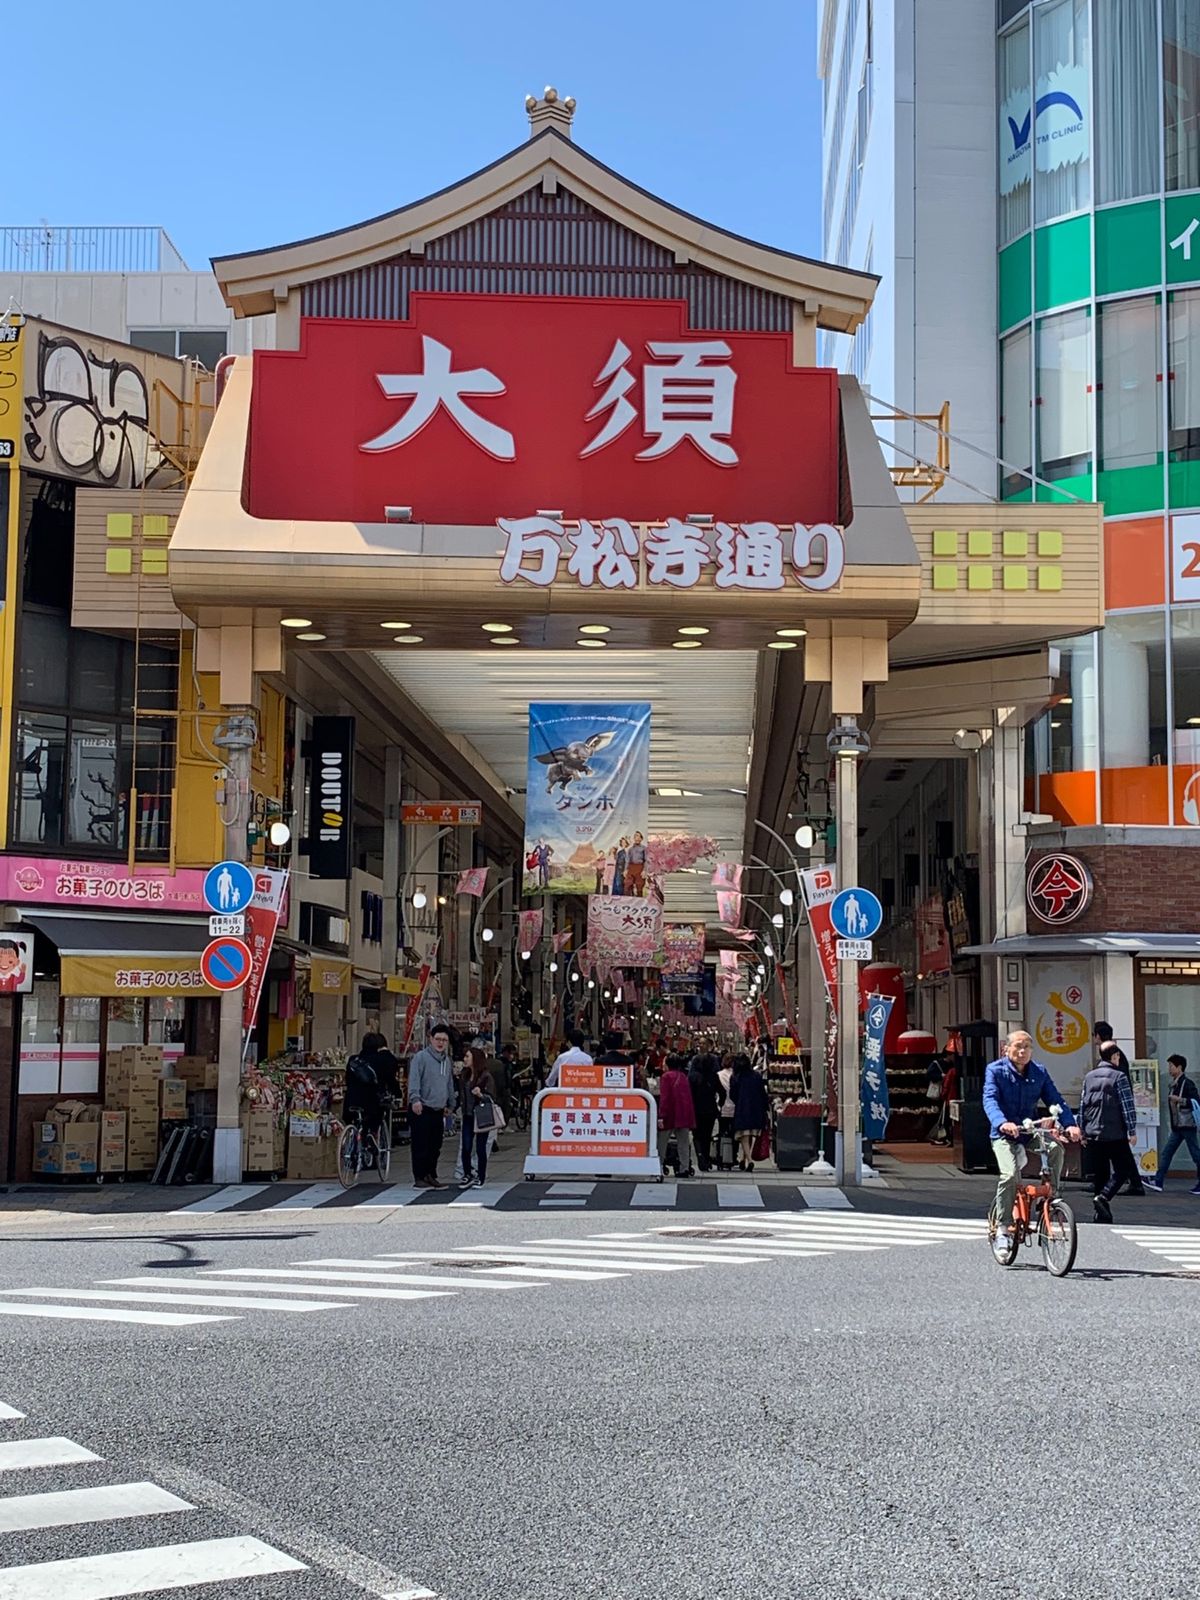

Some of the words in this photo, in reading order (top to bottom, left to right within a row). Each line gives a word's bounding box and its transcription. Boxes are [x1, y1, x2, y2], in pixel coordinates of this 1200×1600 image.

[1037, 134, 1049, 145] TM
[1052, 122, 1083, 139] CLINIC
[1169, 218, 1200, 261] イ
[358, 334, 741, 468] 大須
[496, 516, 846, 593] 万松寺通り
[1180, 542, 1200, 579] 2
[320, 752, 343, 841] DOUTOR
[57, 877, 164, 899] お菓子のひろば
[213, 926, 240, 934] 11-22
[621, 914, 653, 929] 大須
[840, 950, 868, 958] 11-22
[605, 1068, 626, 1078] B-5
[550, 1112, 638, 1125] 車両進入禁止
